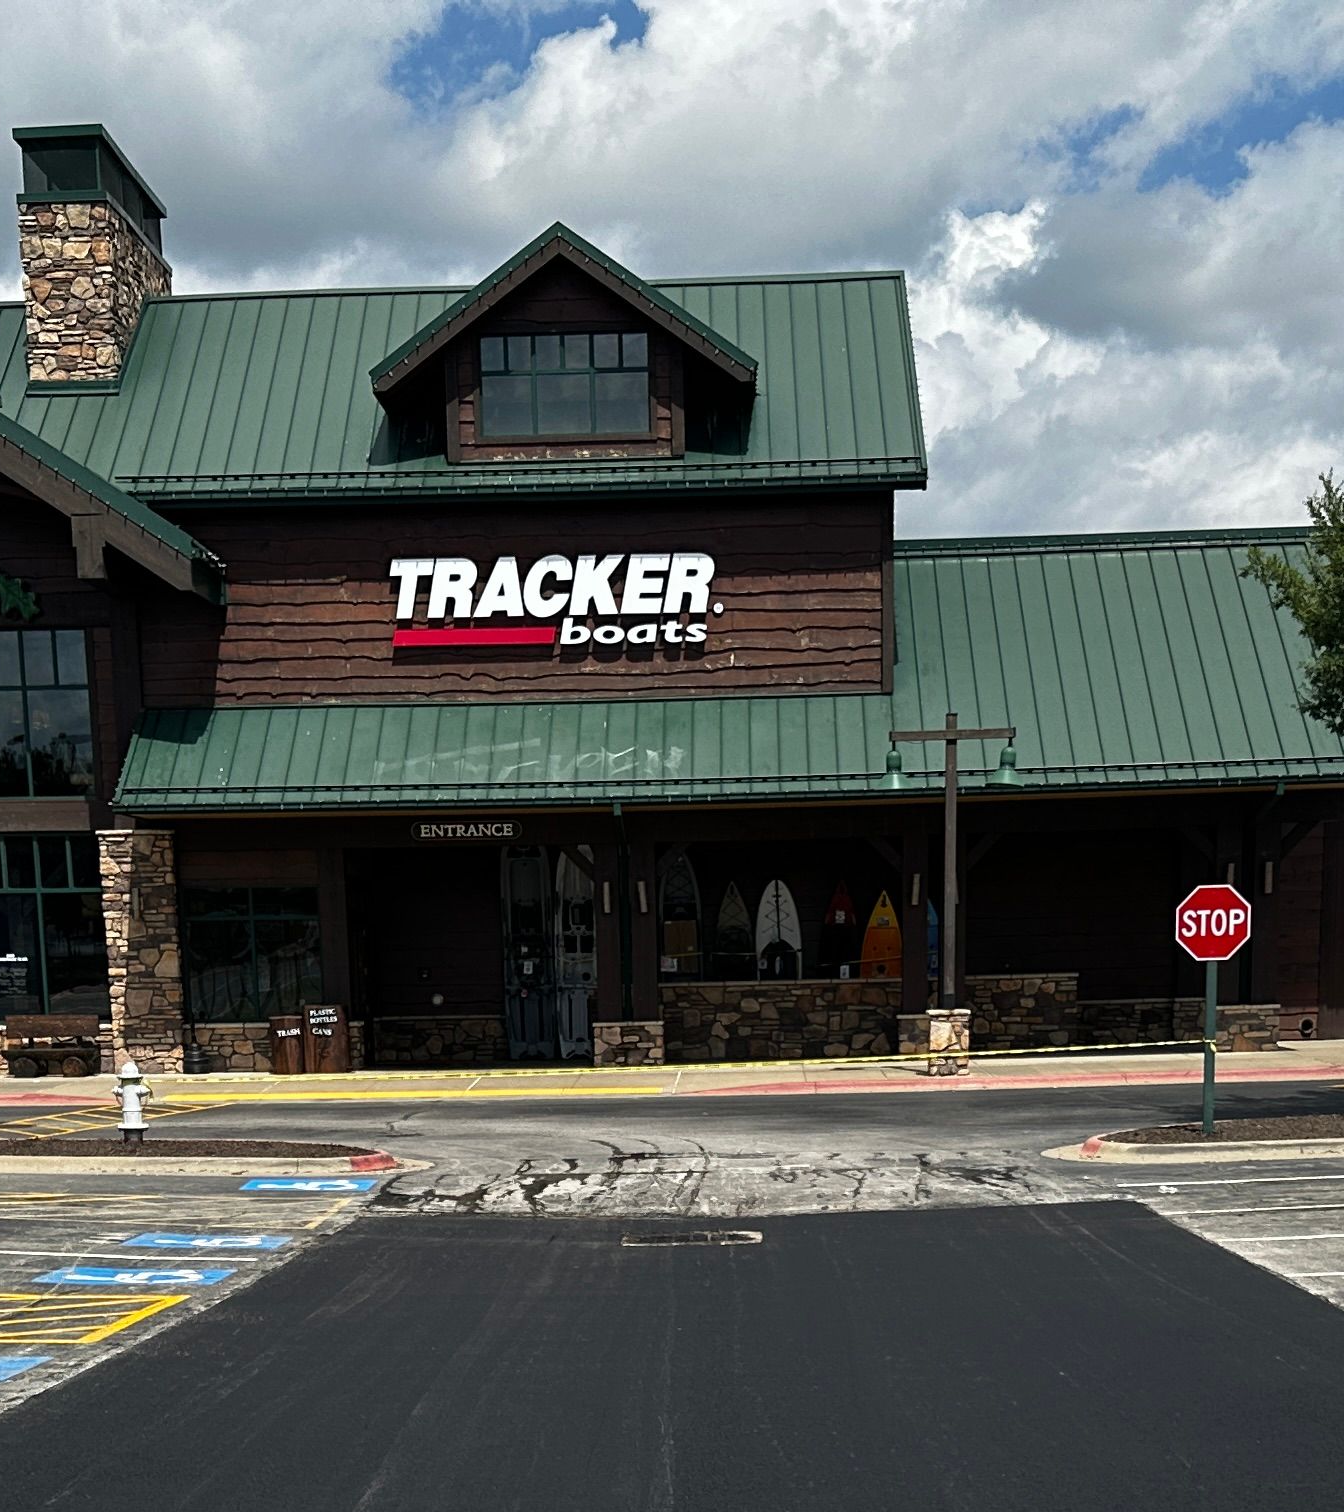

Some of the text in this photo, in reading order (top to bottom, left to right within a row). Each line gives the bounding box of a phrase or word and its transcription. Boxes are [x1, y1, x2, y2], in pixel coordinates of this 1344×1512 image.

[389, 553, 715, 619] TRACKER
[560, 618, 708, 645] boats
[420, 824, 513, 837] ENTRANCE
[1181, 908, 1246, 938] STOP
[309, 1008, 336, 1017] PLASTIC
[309, 1016, 338, 1024] BOTTLES
[276, 1027, 301, 1038] TRASH
[312, 1027, 333, 1036] CANS
